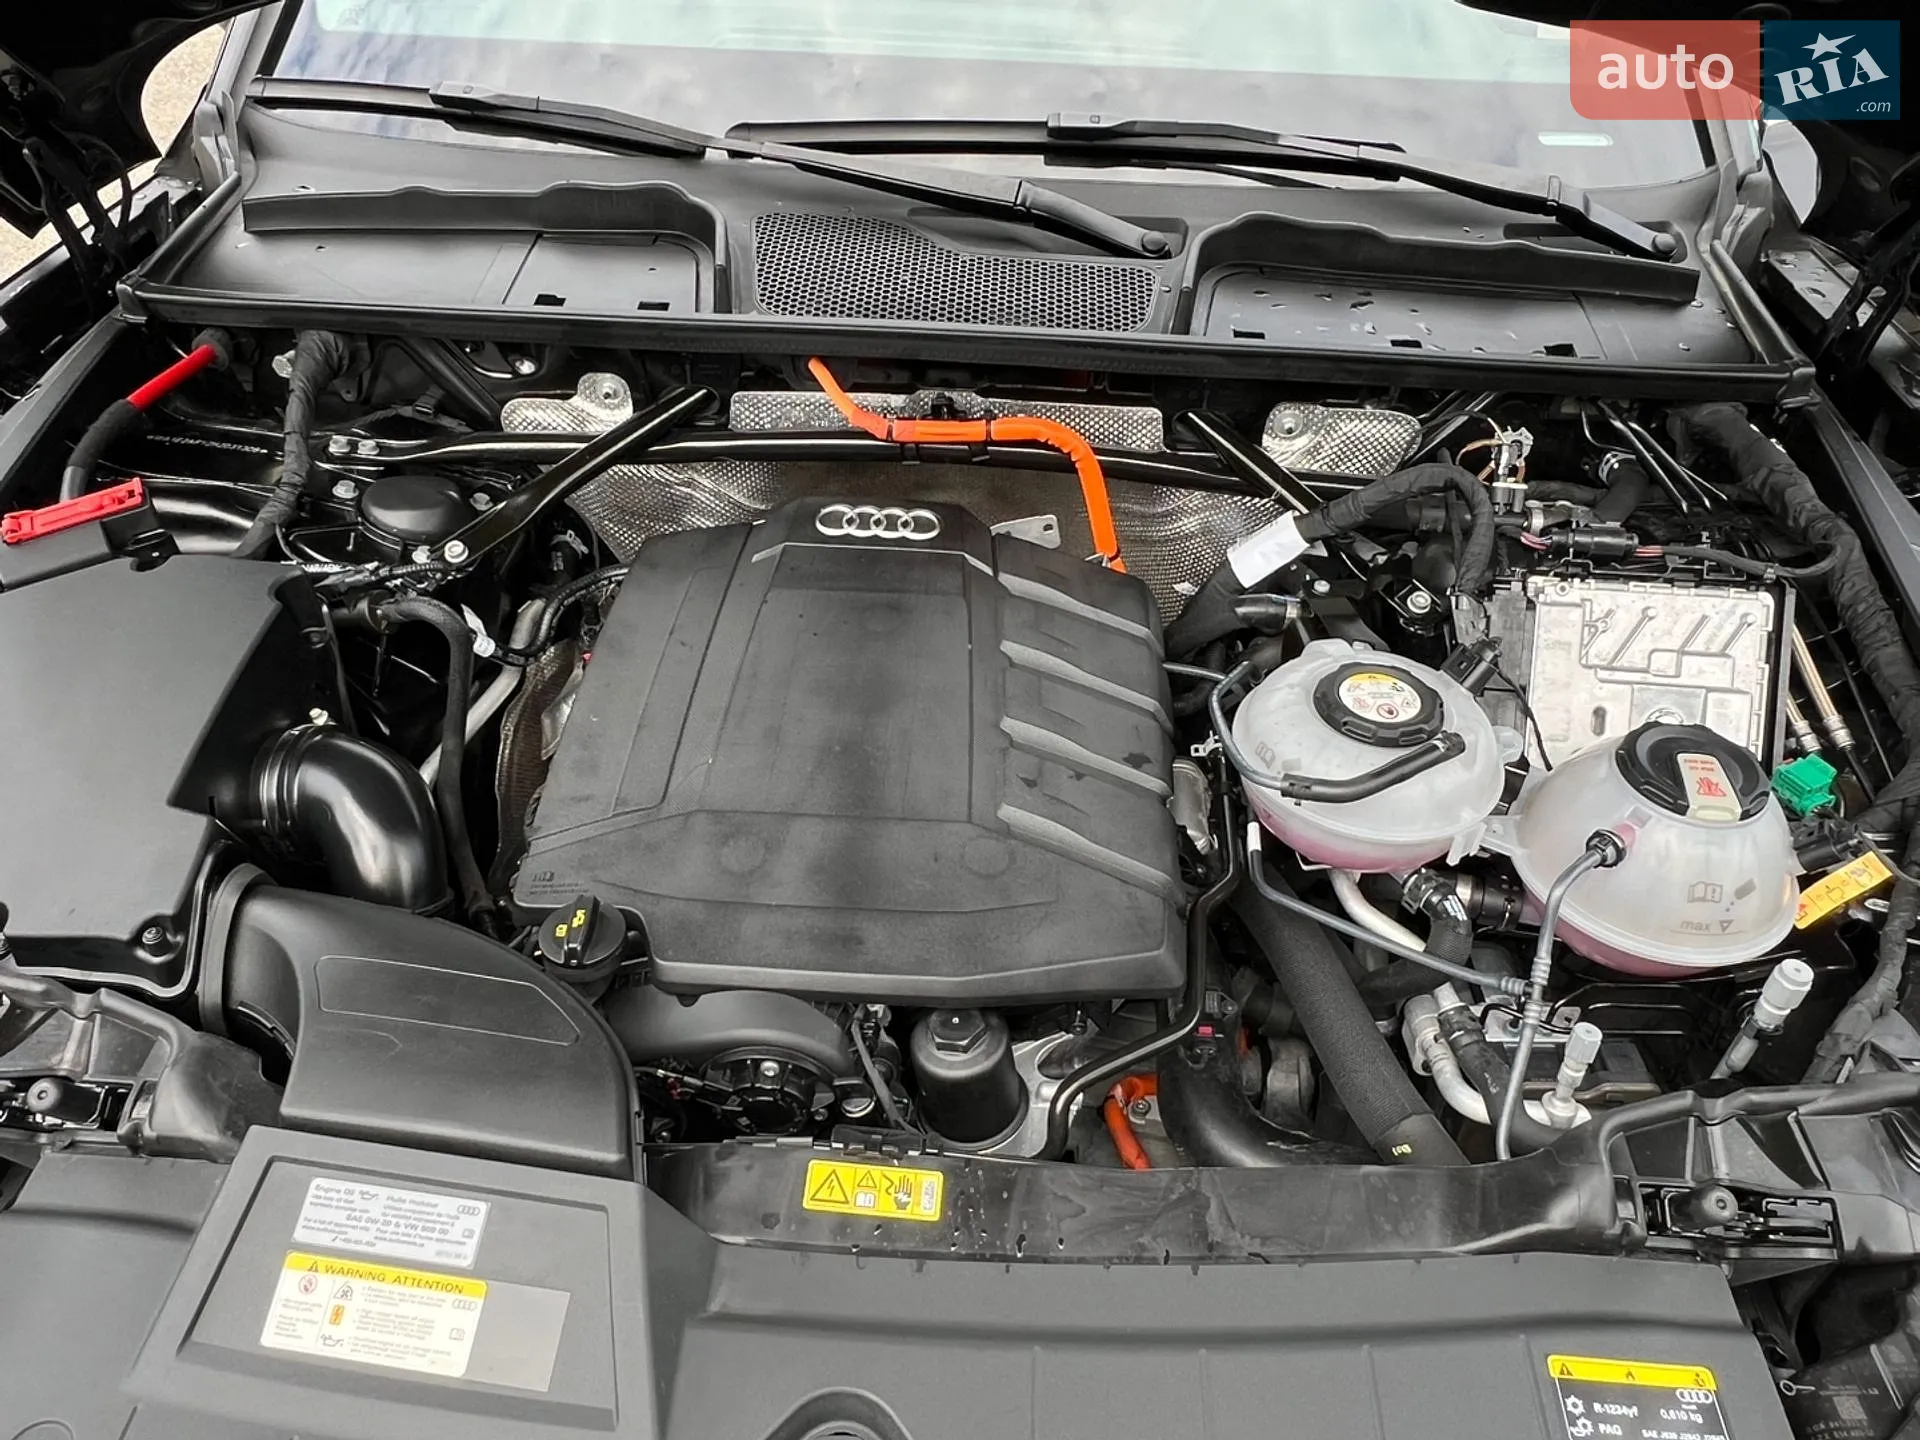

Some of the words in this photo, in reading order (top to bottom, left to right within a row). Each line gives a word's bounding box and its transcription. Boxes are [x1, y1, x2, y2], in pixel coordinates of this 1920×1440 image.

[1680, 920, 1710, 932] max
[325, 1264, 386, 1282] WARNING
[392, 1275, 464, 1294] ATTENTION
